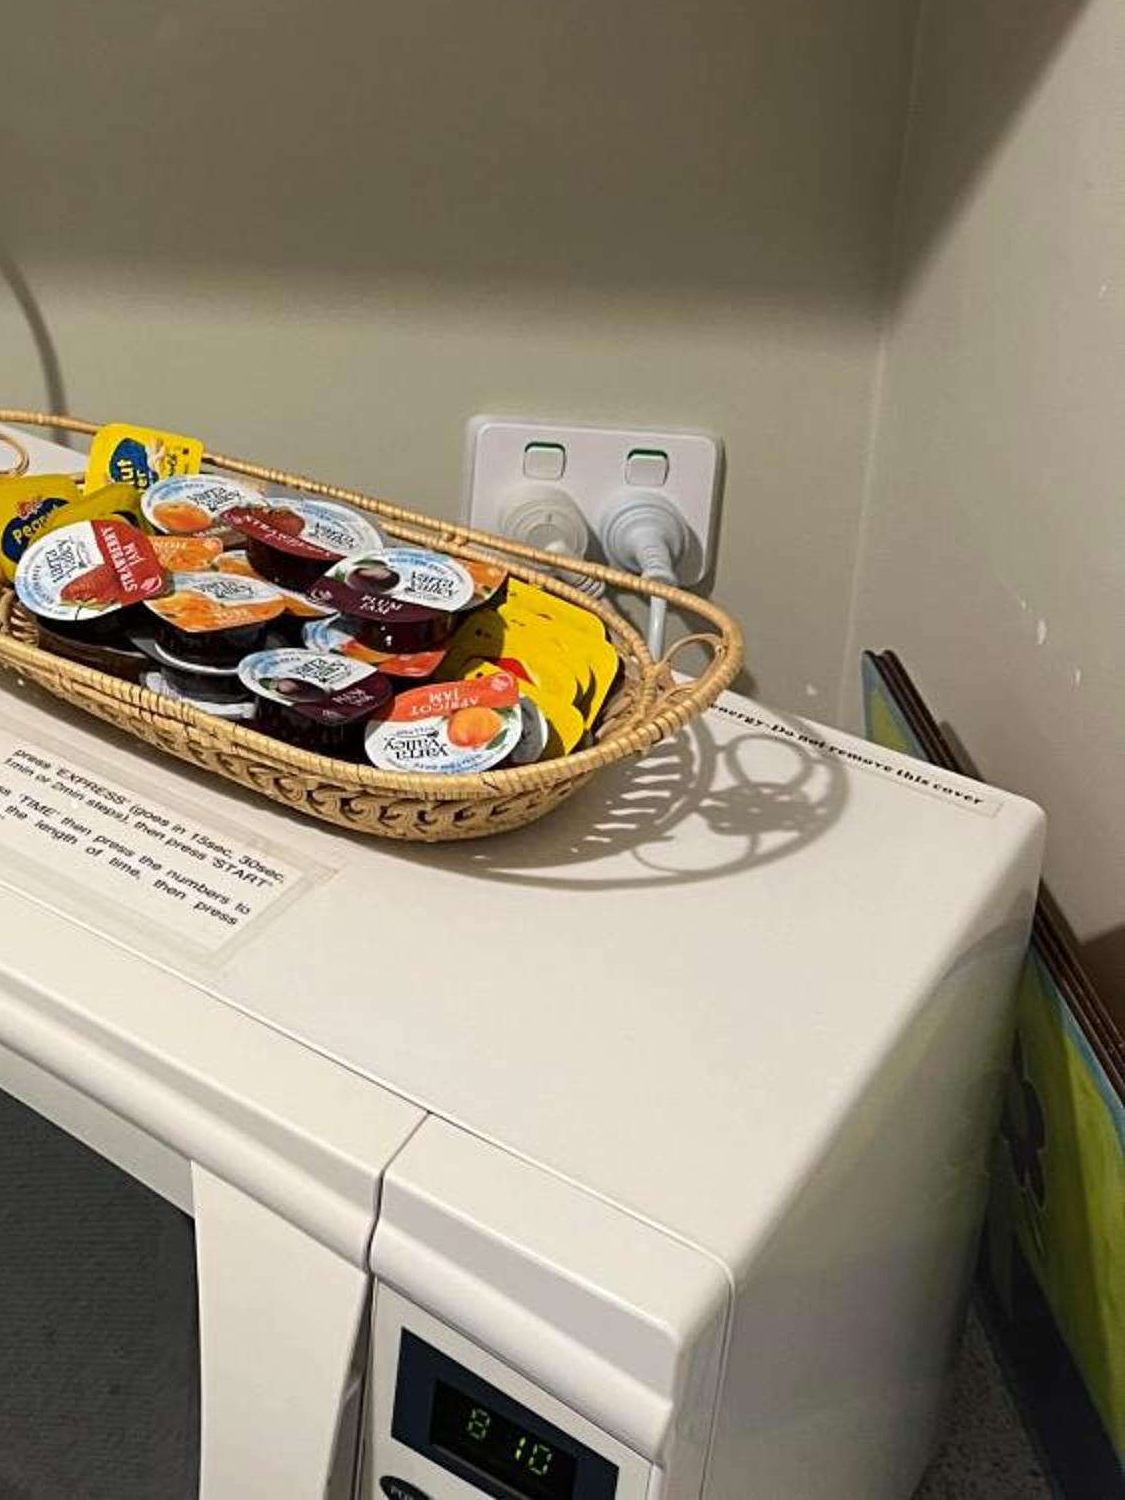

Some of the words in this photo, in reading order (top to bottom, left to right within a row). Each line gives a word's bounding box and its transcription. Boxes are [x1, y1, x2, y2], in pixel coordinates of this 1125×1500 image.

[101, 525, 139, 593] STRAWBERRY
[122, 541, 144, 566] JAM
[359, 602, 390, 616] JAM
[361, 594, 404, 612] PLUM
[410, 696, 479, 716] APRICOT
[429, 688, 460, 704] JAM
[12, 749, 52, 770] press
[128, 804, 170, 828] (goes
[171, 823, 187, 836] in
[797, 734, 826, 750] not
[828, 745, 894, 773] remove
[895, 768, 930, 786] this
[931, 782, 984, 805] cover
[3, 757, 35, 778] 1min
[35, 773, 52, 784] or
[50, 781, 86, 802] 2min
[133, 821, 167, 842] then
[164, 837, 209, 862] press
[3, 804, 30, 821] the
[34, 819, 79, 846] length
[85, 844, 102, 861] of
[151, 878, 188, 901] then
[191, 899, 240, 927] press
[60, 815, 93, 837] then
[91, 834, 137, 859] press
[137, 854, 164, 872] the
[165, 868, 231, 906] numbers
[233, 901, 253, 917] to
